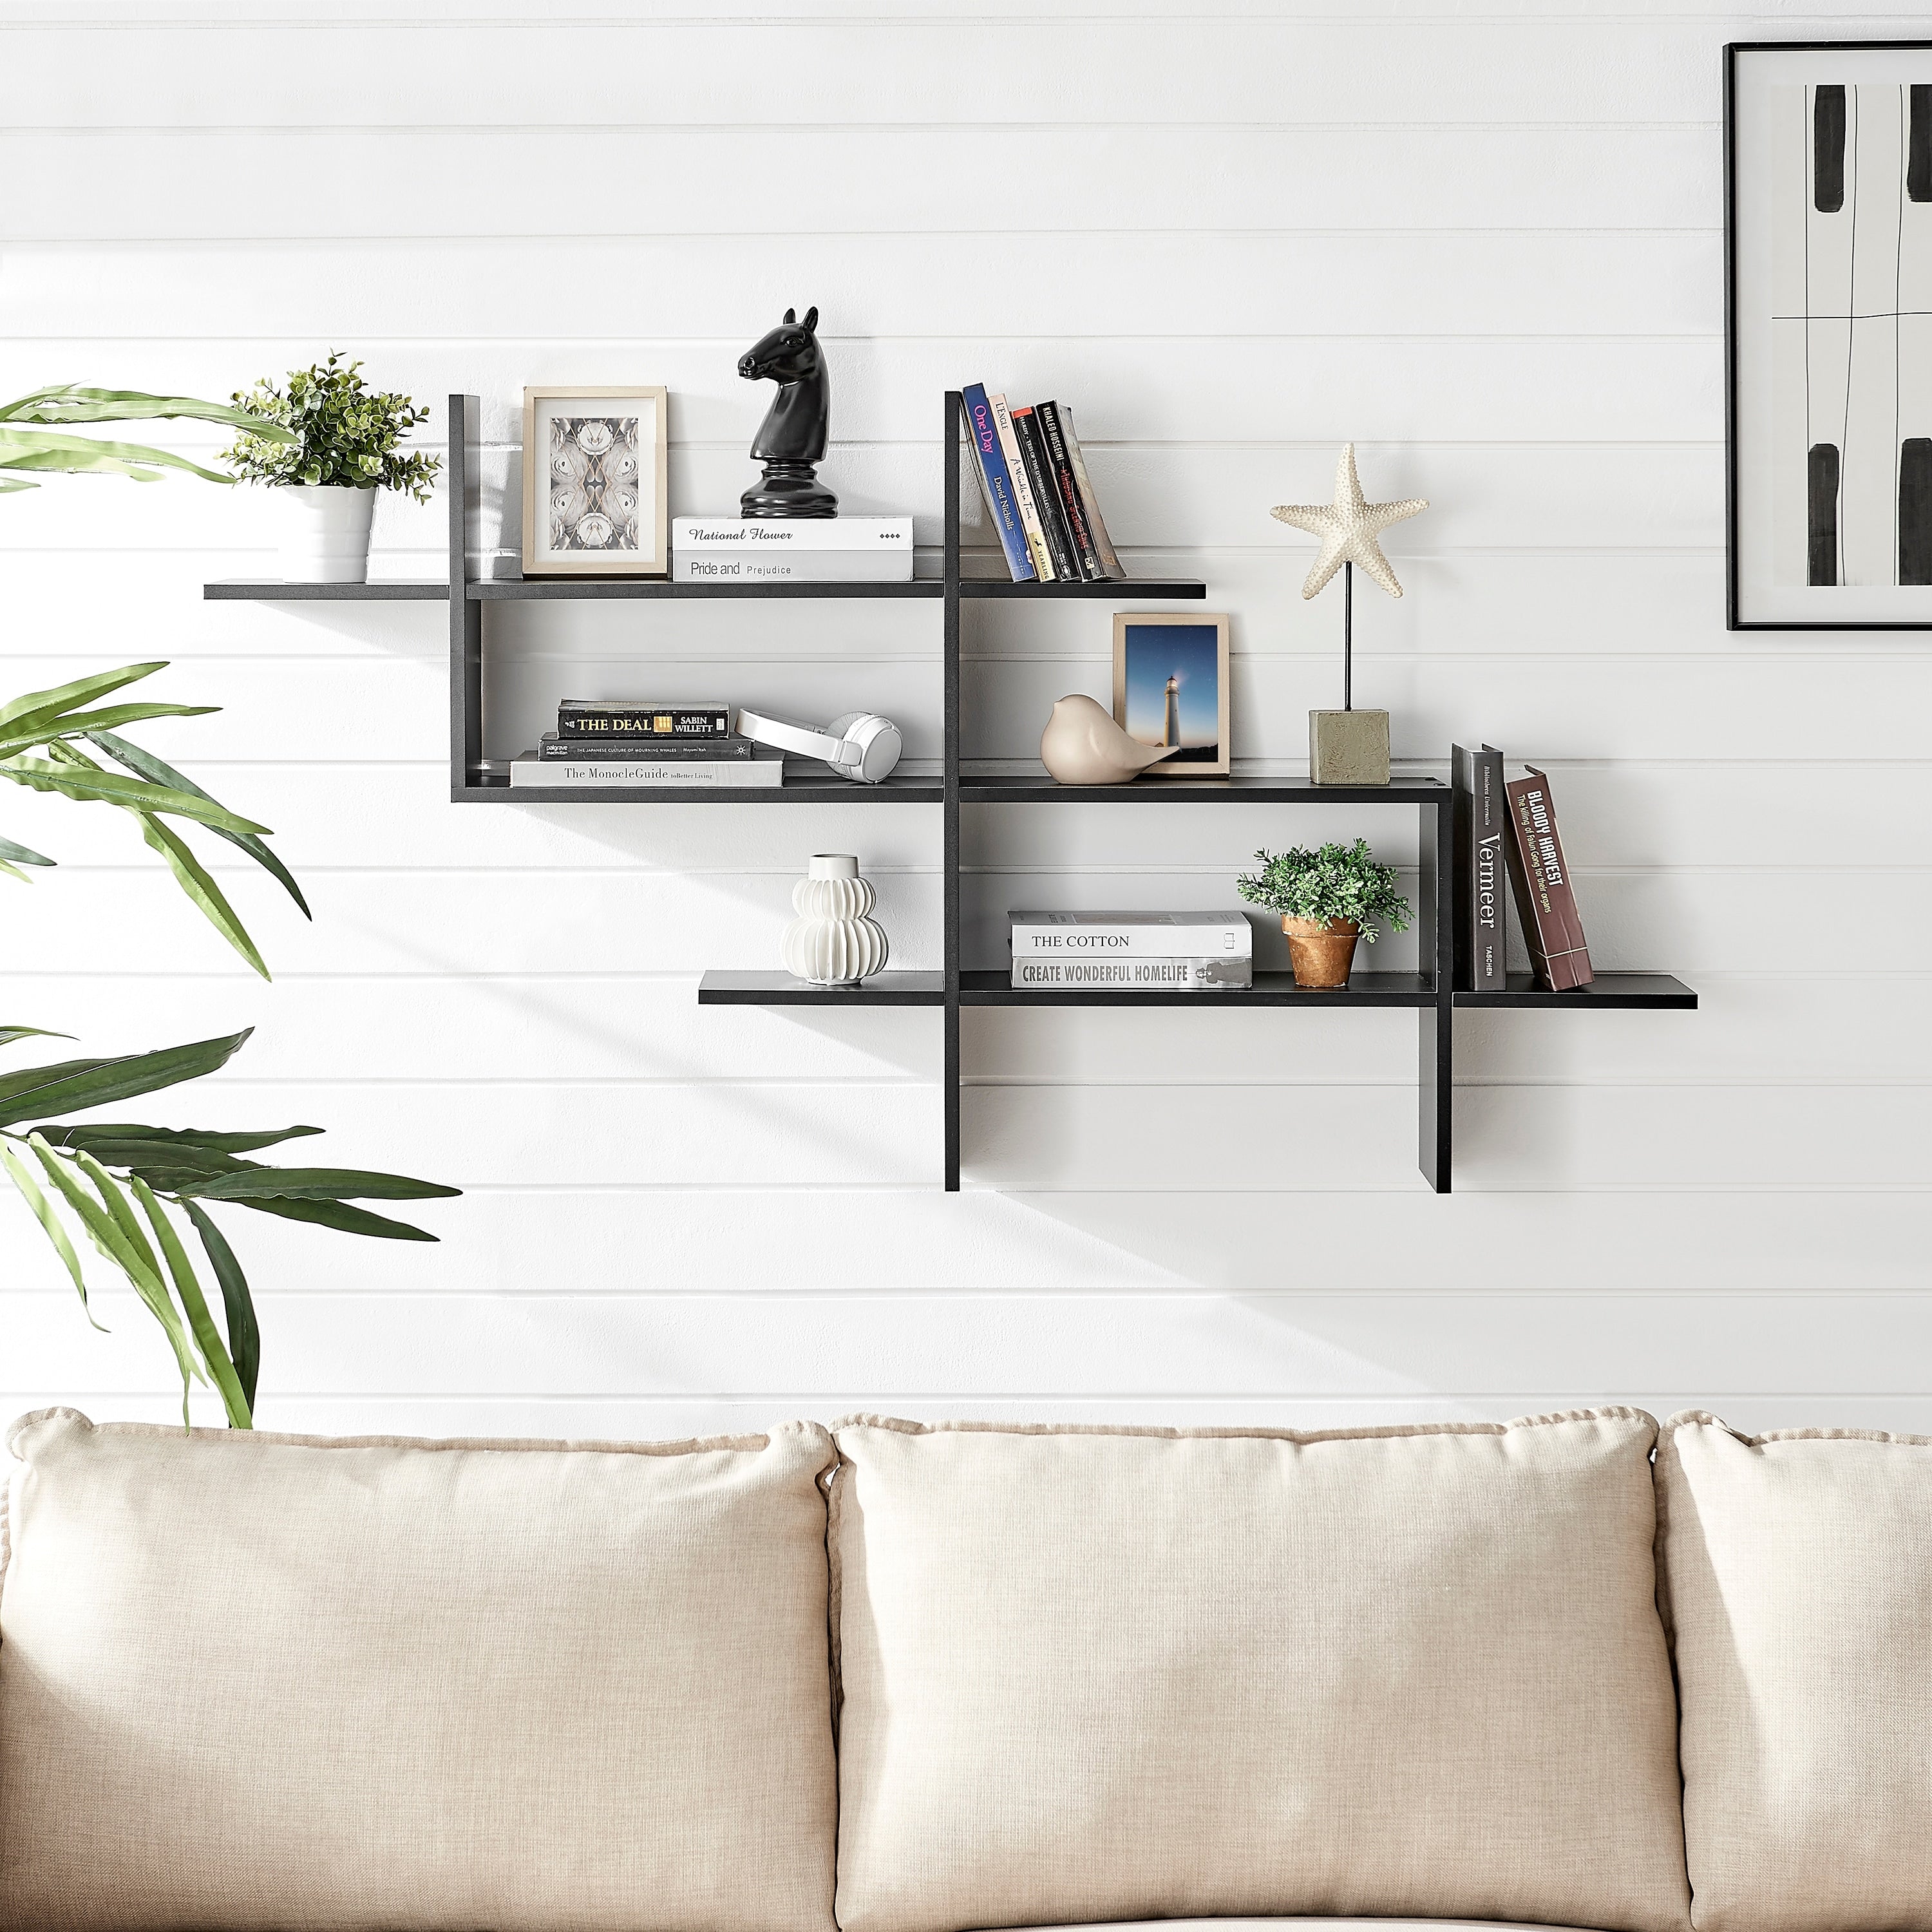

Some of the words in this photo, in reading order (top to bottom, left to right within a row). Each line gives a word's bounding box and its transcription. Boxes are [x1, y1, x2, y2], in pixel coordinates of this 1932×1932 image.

[974, 405, 987, 430] One
[981, 430, 993, 453] Day
[1019, 417, 1028, 435] HARDY
[1030, 451, 1036, 460] OF
[1050, 431, 1065, 461] HOSSEINI
[1016, 466, 1027, 494] Wrinkle
[1023, 502, 1034, 520] Time
[994, 477, 1007, 499] David
[1001, 500, 1014, 530] Nicholls
[689, 529, 746, 540] National
[750, 528, 793, 540] Flower
[691, 562, 717, 574] Pride
[720, 562, 740, 574] and
[747, 566, 791, 576] Prejudice
[1038, 551, 1049, 578] YEARLING
[577, 719, 609, 731] THE
[612, 719, 652, 731] DEAL
[564, 768, 585, 779] The
[588, 767, 668, 779] MonocleGuide
[1517, 795, 1526, 806] The
[1520, 806, 1530, 826] killing
[1528, 790, 1551, 833] BLOODY
[1527, 834, 1536, 851] Falun
[1531, 851, 1540, 867] Gong
[1538, 837, 1563, 886] HARVEST
[1478, 832, 1501, 929] Vermeer
[1535, 867, 1544, 876] for
[1537, 876, 1546, 892] their
[1540, 893, 1551, 913] organs
[1032, 936, 1062, 947] THE
[1066, 936, 1130, 947] COTTON
[1023, 965, 1061, 981] CREATE
[1065, 965, 1130, 981] WONDERFUL
[1135, 965, 1188, 981] HOMELIFE
